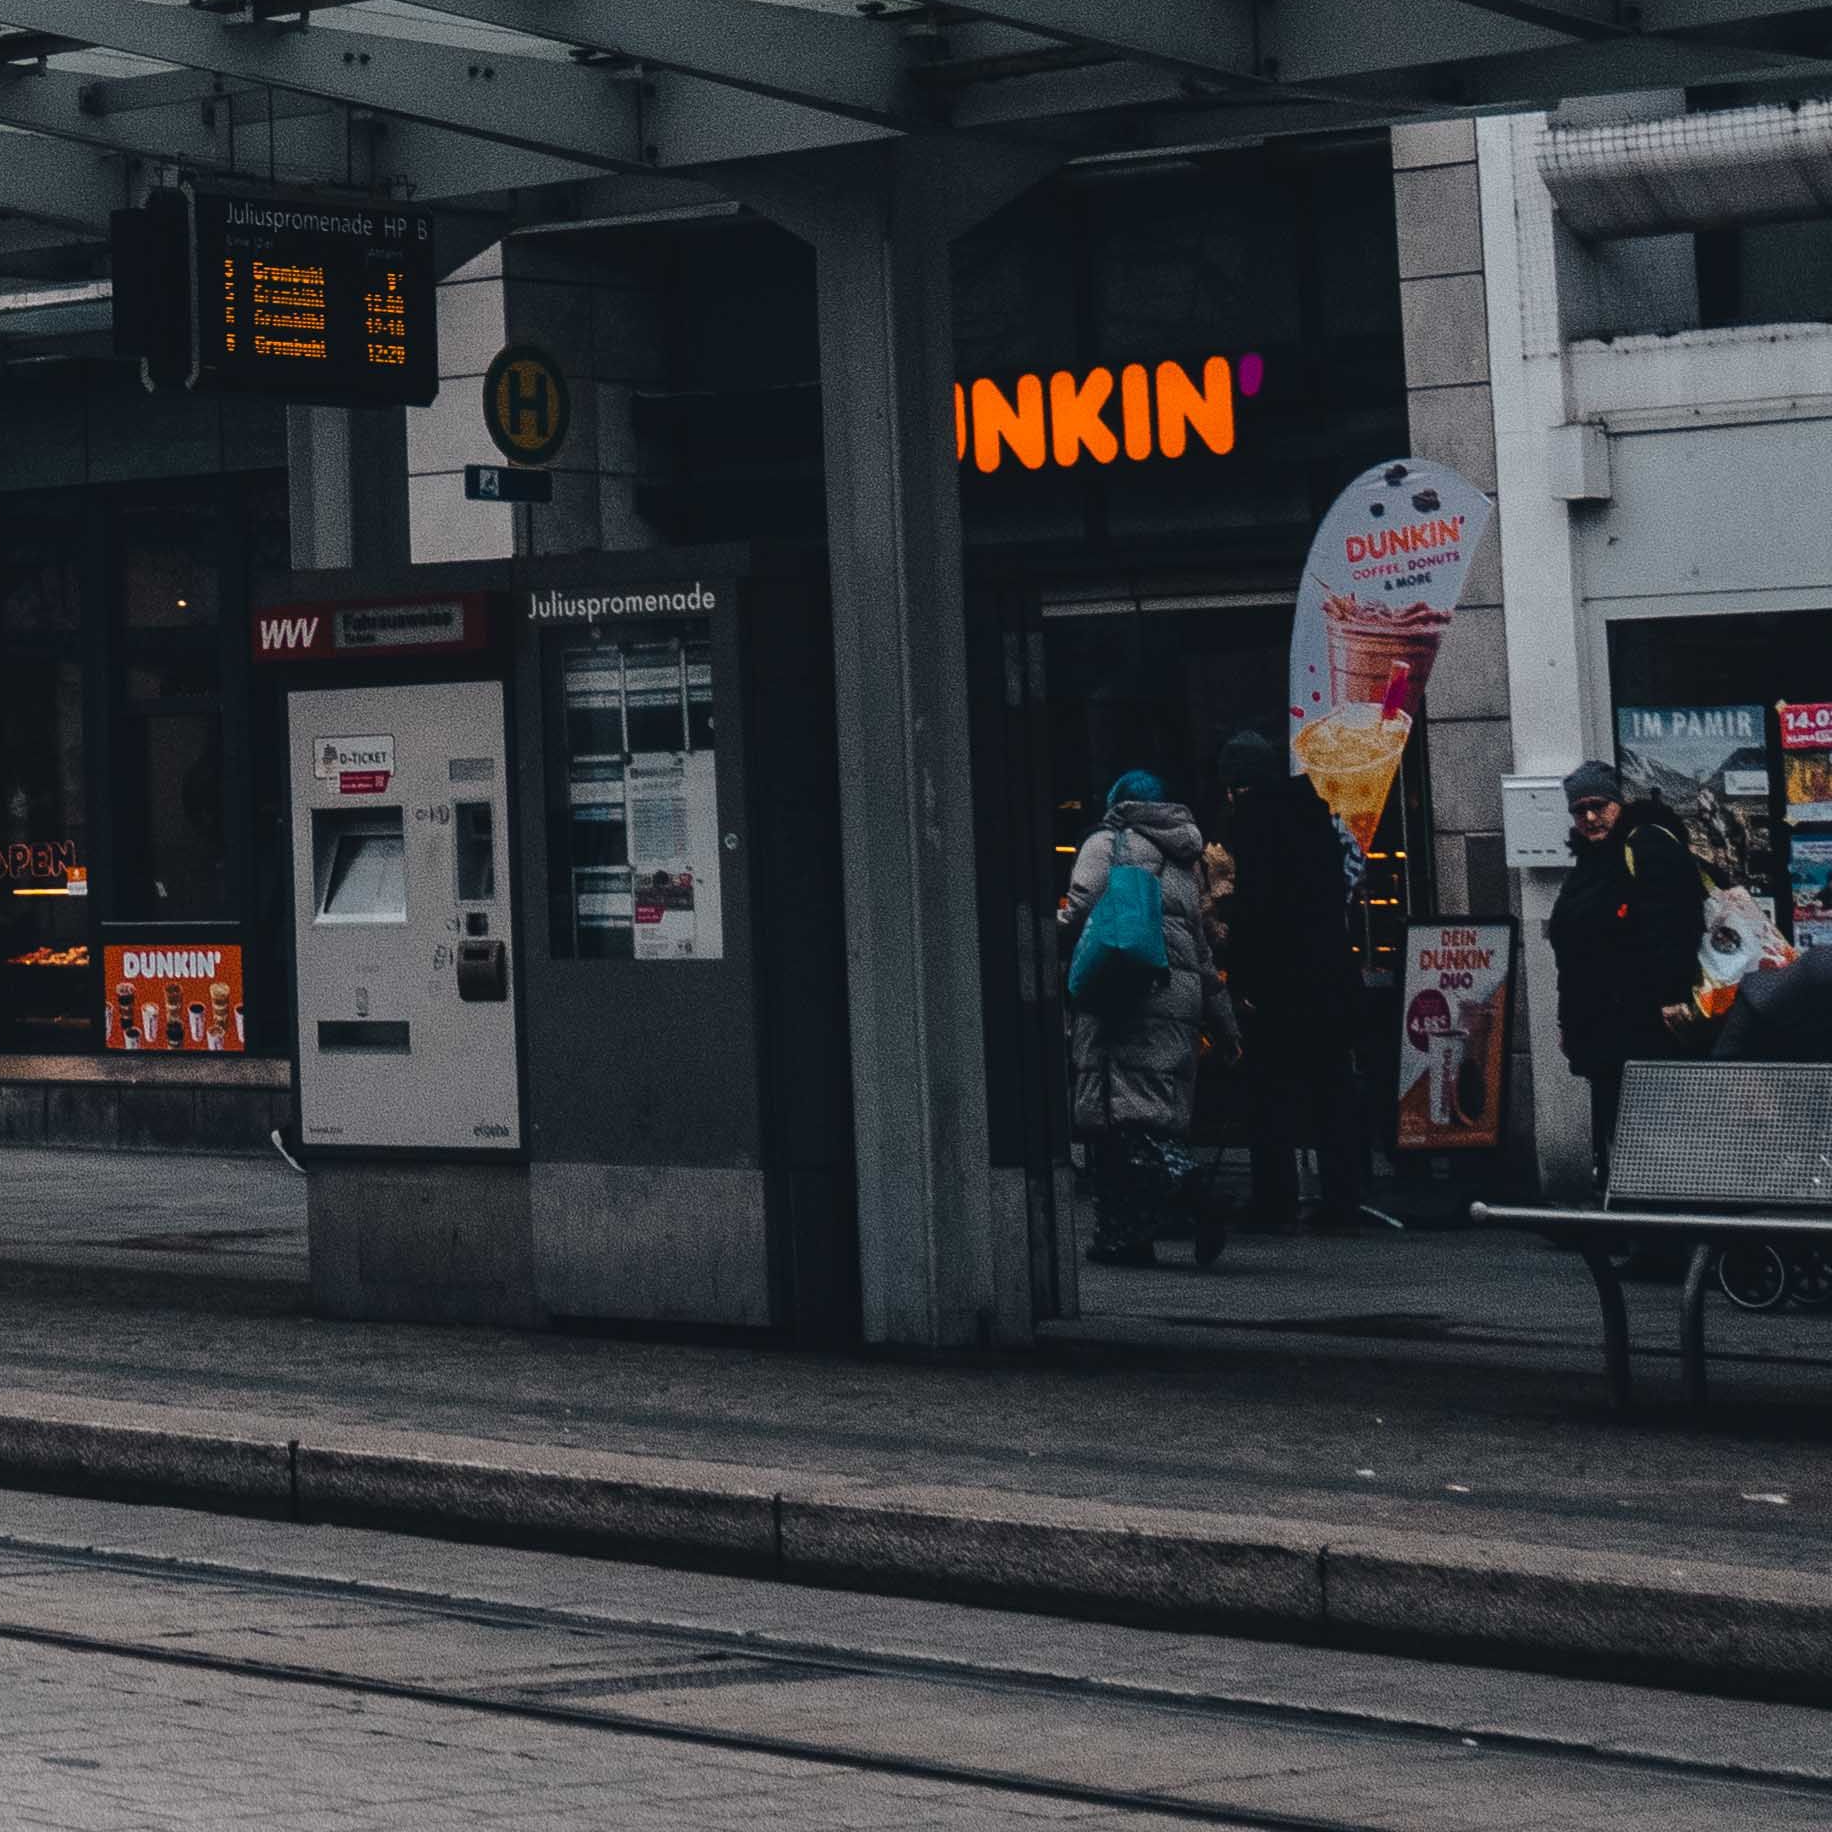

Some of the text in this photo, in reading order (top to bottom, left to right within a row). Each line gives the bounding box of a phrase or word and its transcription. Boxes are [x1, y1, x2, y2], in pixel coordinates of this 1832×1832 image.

[226, 201, 429, 241] Juliuspromenade HP B
[510, 370, 548, 436] H
[953, 352, 1265, 474] NKIN'
[1346, 515, 1465, 564] DUNKIN'
[1408, 551, 1461, 571] DONUTS
[1396, 572, 1432, 588] MORE
[527, 581, 716, 623] Juliuspromenade
[260, 616, 319, 650] WVV
[1632, 709, 1752, 737] IM PAMIR
[1786, 709, 1832, 730] 14.0
[340, 752, 386, 765] D-TICKET
[1441, 930, 1476, 947] DEIN
[122, 951, 221, 979] DUNKIN'
[1419, 950, 1494, 970] DUNKIN'
[1440, 973, 1473, 989] DUO
